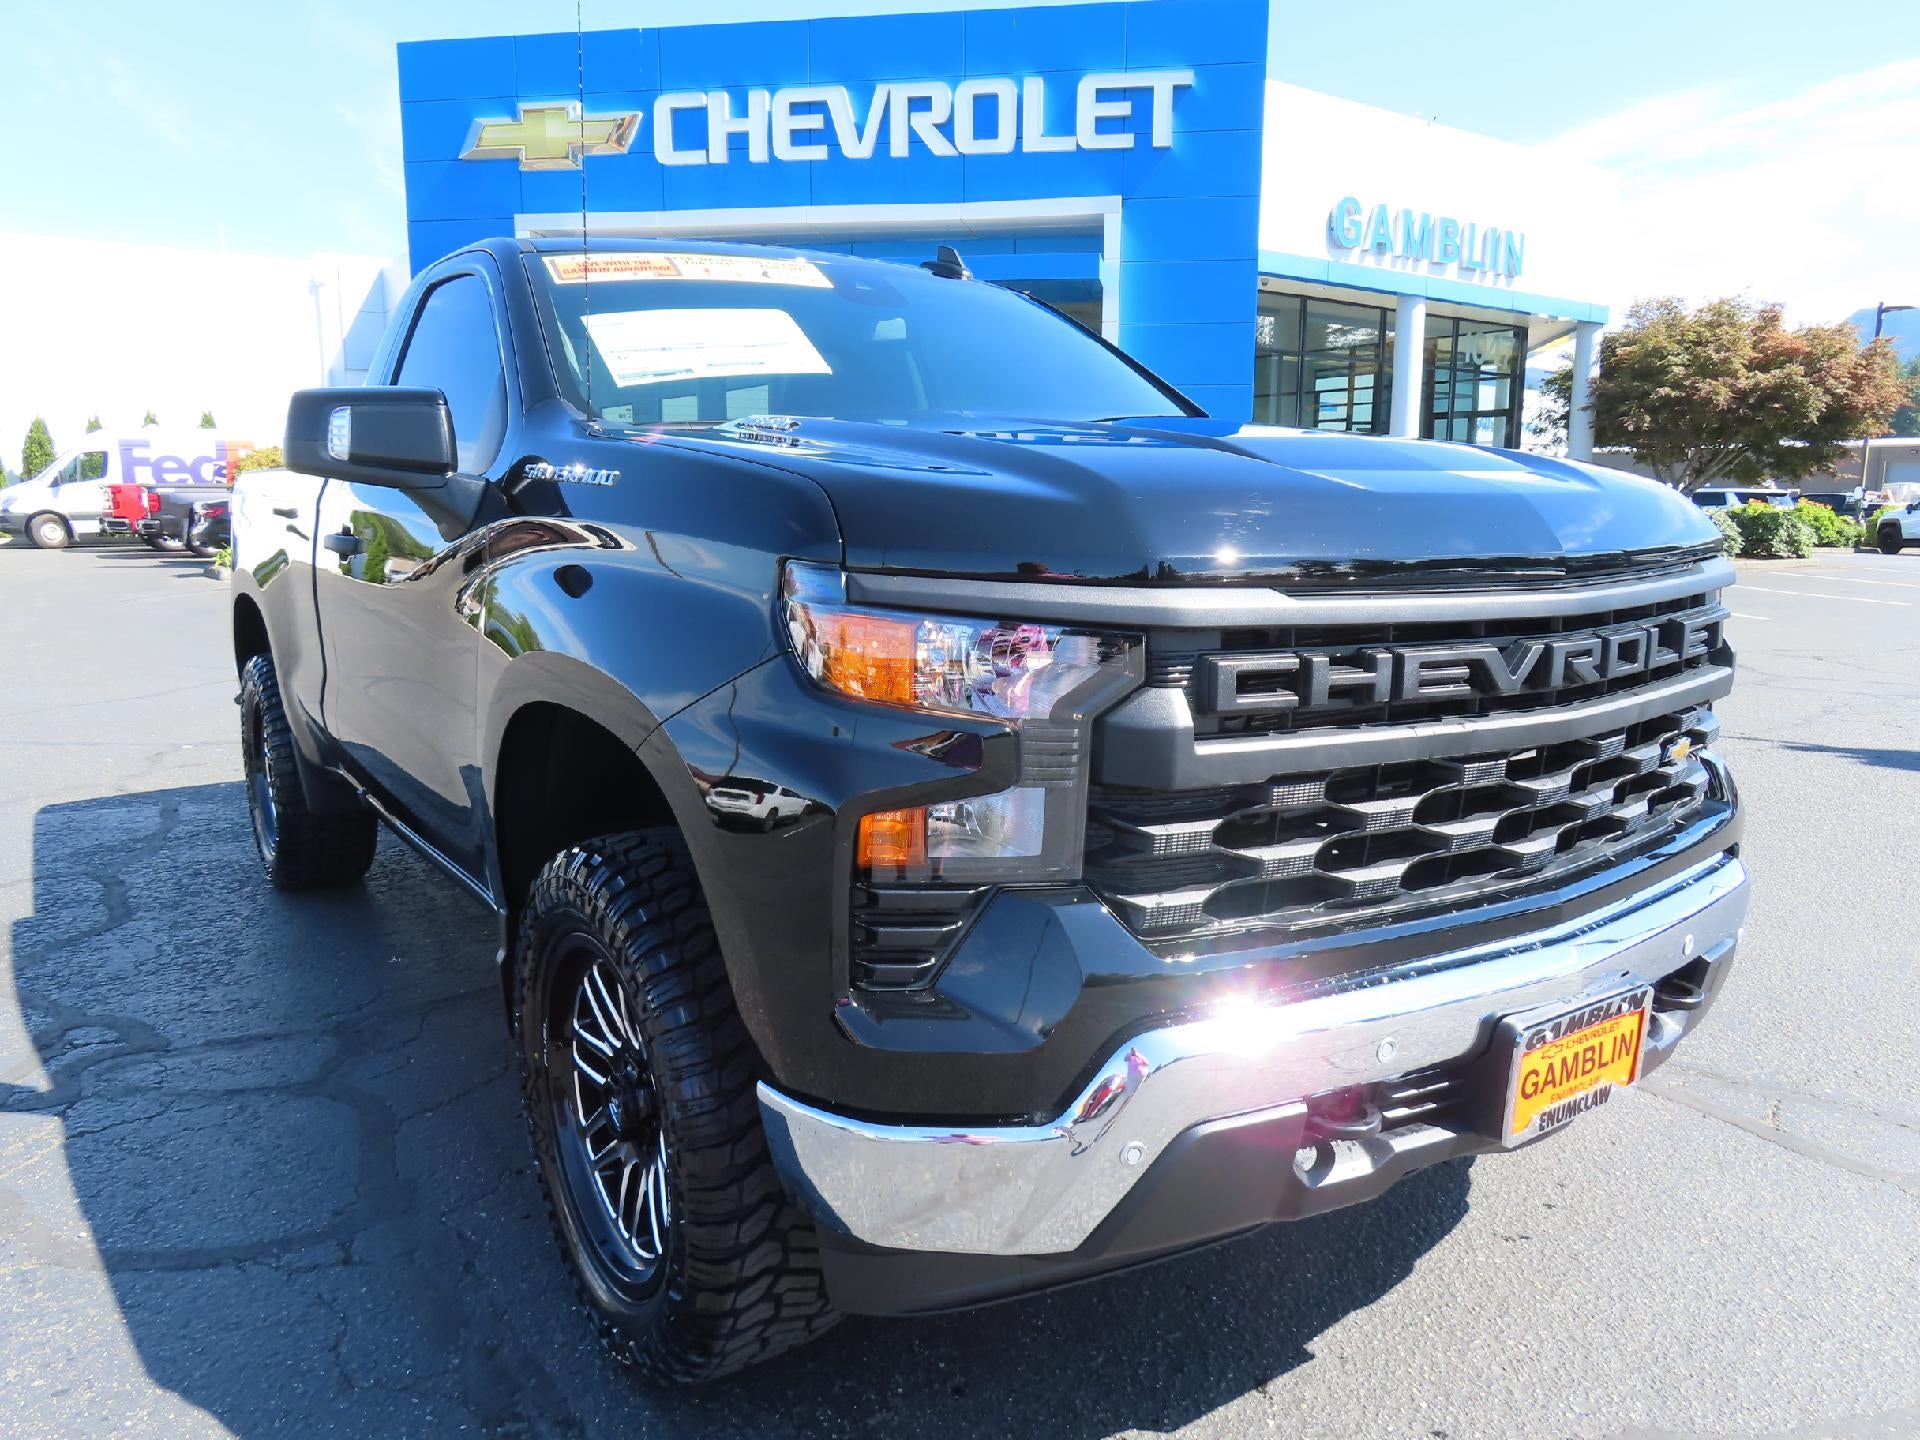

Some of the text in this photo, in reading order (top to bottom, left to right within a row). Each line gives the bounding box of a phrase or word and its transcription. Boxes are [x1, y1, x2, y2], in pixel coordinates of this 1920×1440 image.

[653, 70, 1195, 166] CHEVROLET
[1329, 196, 1525, 277] GAMBLIN
[1208, 606, 1731, 712] CHEVROLET
[1525, 990, 1648, 1050] GAMBLIN
[1566, 1021, 1620, 1049] CHEVROLET
[1521, 1029, 1634, 1099] GAMBLIN
[1538, 1083, 1613, 1132] ENUMCLAW
